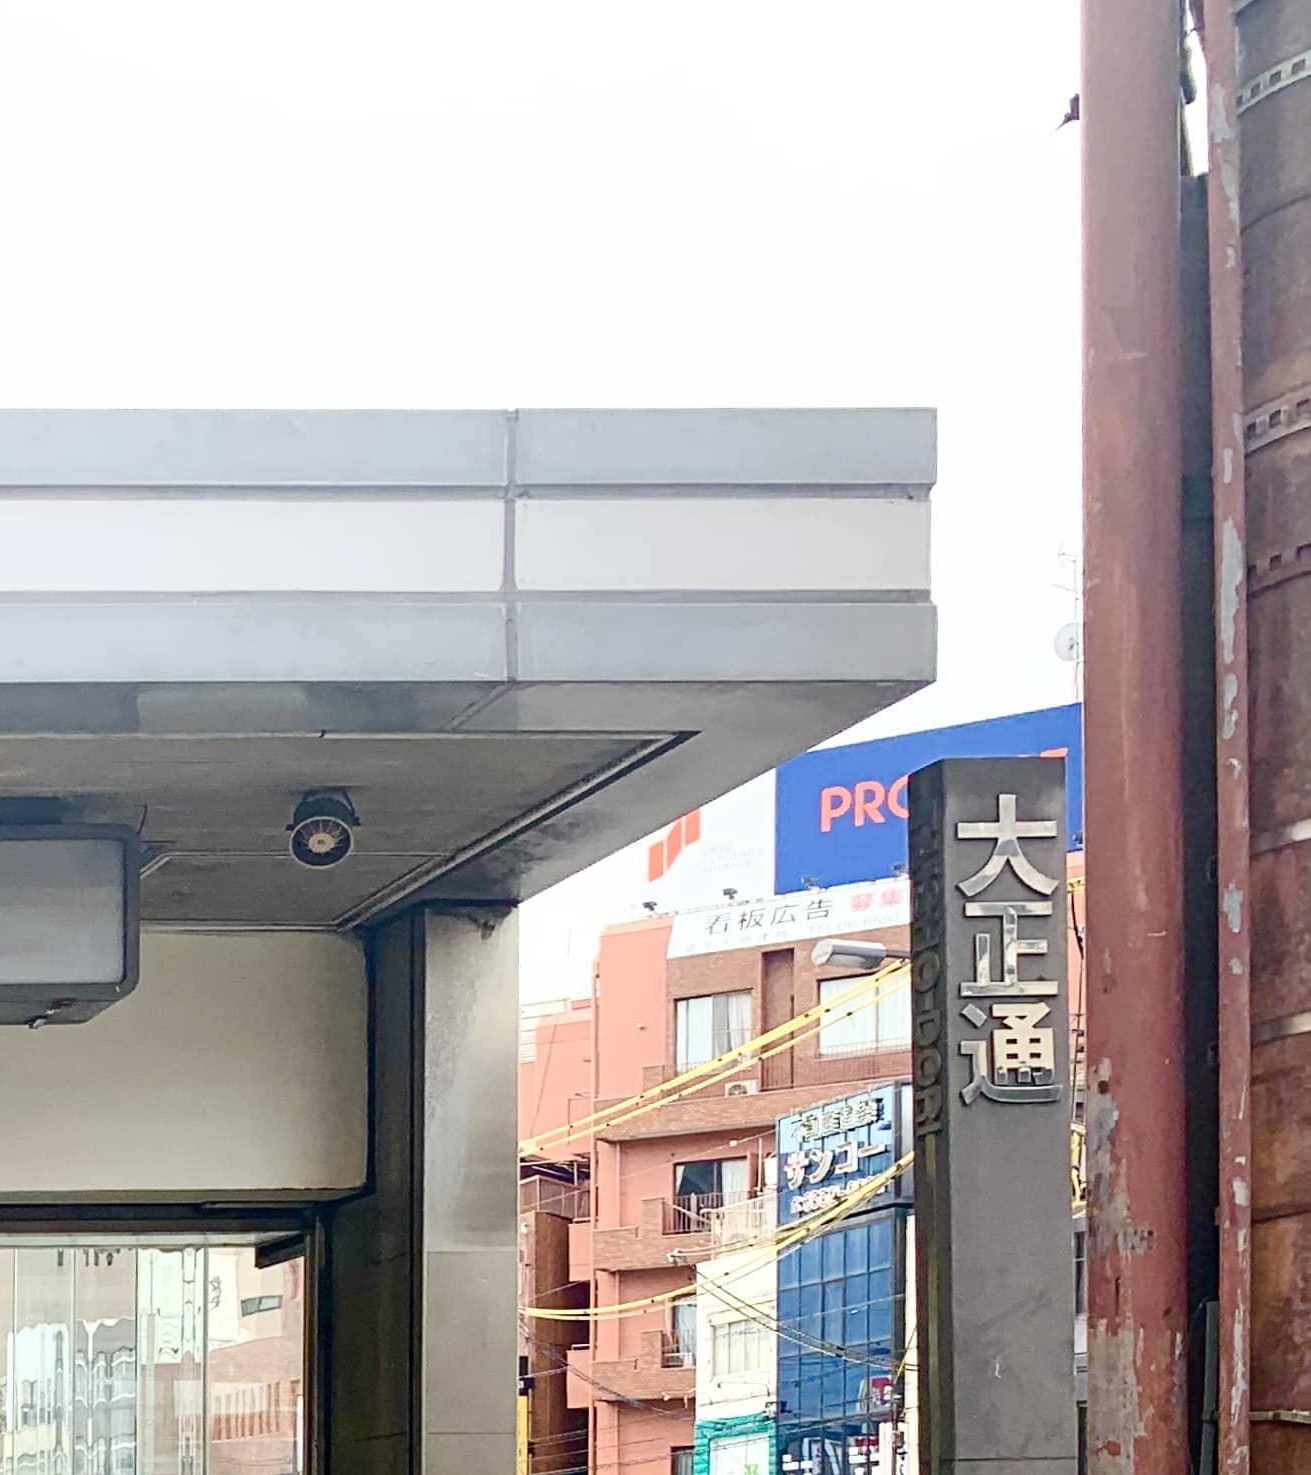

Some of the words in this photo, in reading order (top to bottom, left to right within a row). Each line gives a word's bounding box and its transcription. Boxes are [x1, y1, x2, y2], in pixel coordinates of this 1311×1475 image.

[704, 898, 833, 936] 看板広告
[954, 793, 1064, 1105] 大正通
